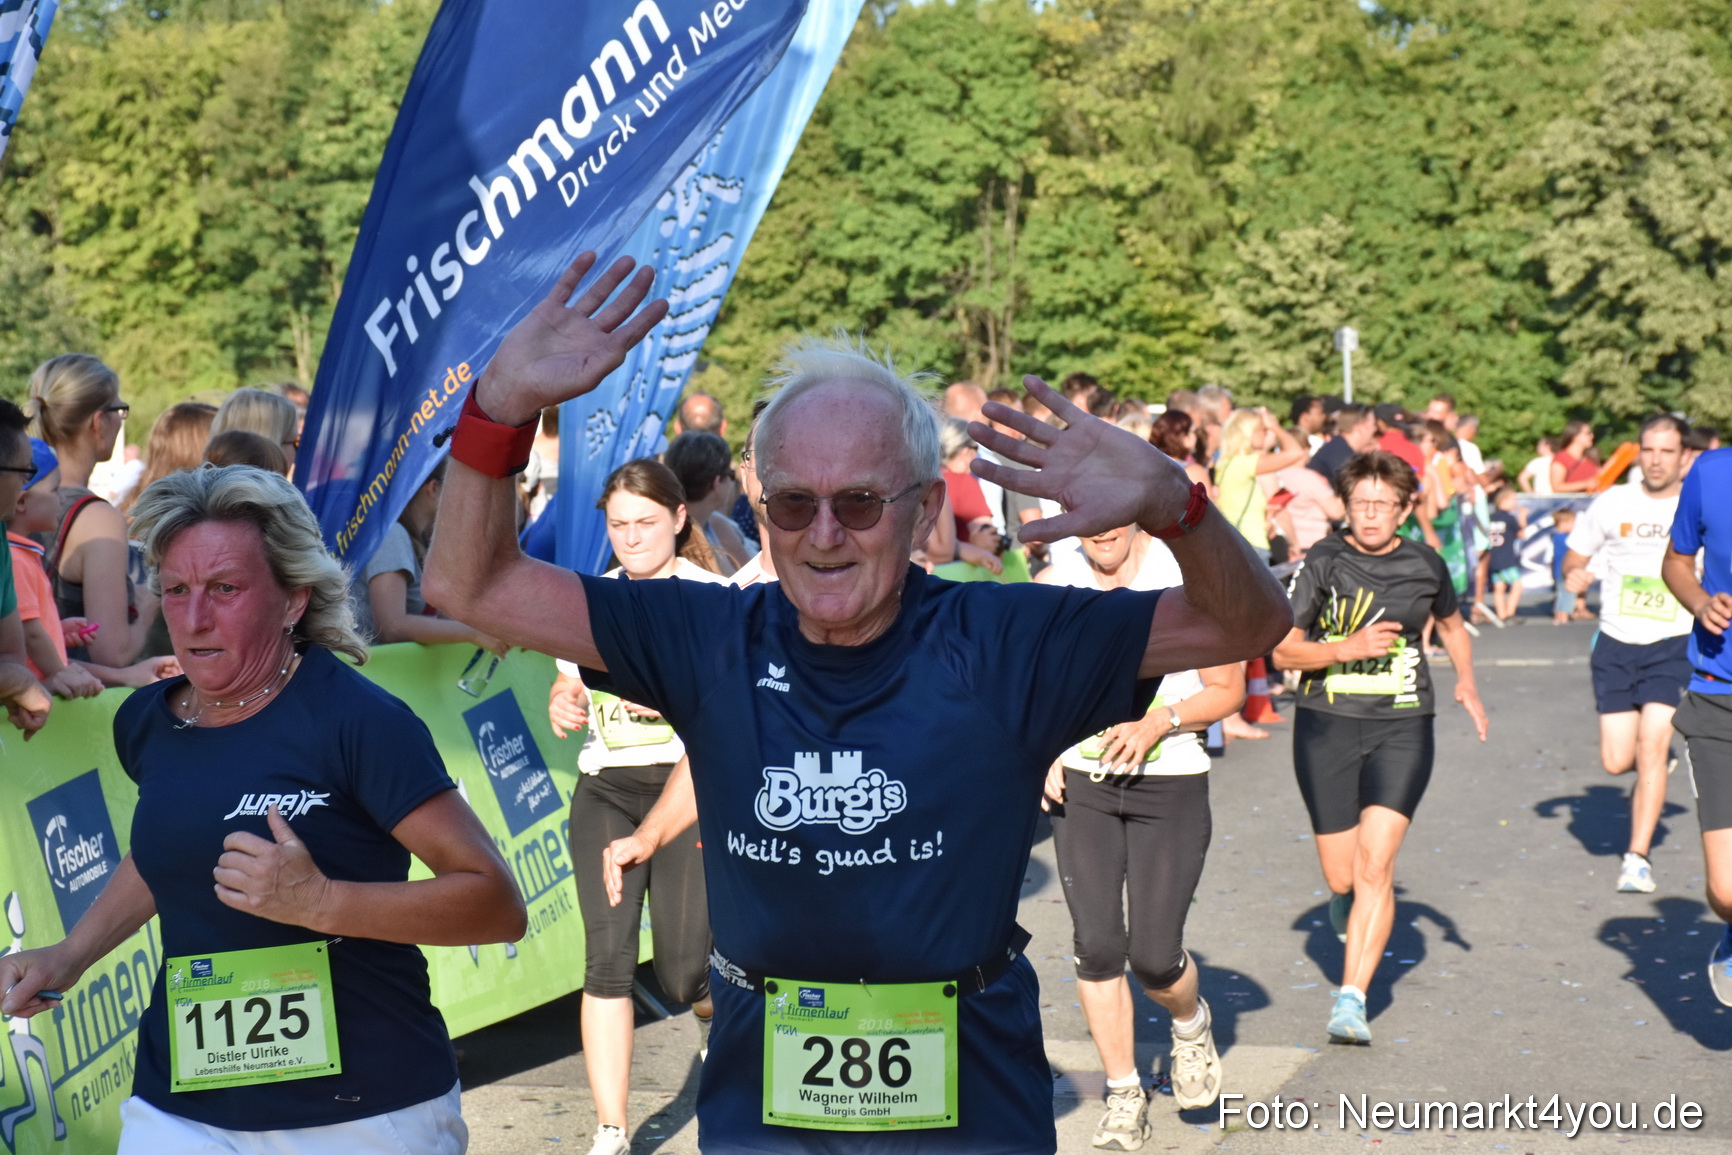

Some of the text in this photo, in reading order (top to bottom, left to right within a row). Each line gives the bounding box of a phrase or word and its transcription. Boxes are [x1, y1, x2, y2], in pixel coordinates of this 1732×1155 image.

[557, 0, 750, 207] Druck und Me
[364, 0, 671, 378] Frischmann
[1633, 590, 1665, 608] 729
[756, 677, 790, 693] erima
[488, 734, 525, 769] Fischer
[756, 767, 906, 834] Burgis
[56, 831, 104, 874] Fischer
[727, 830, 943, 875] Weil's guad is!
[69, 860, 108, 894] AUTOMOBILE
[183, 972, 234, 989] firmenlauf
[241, 979, 271, 992] 2018
[186, 992, 310, 1050] 1125
[788, 1003, 850, 1020] firmenlauf
[858, 1019, 893, 1031] 2018
[208, 1046, 289, 1064] Distler Ulrike
[802, 1036, 912, 1088] 286
[195, 1062, 241, 1077] Lebenshilfe
[243, 1059, 286, 1071] Neumarkt
[288, 1056, 306, 1066] e.V.
[799, 1089, 918, 1106] Wagner Wilhelm
[824, 1107, 891, 1118] Burgis GmbH
